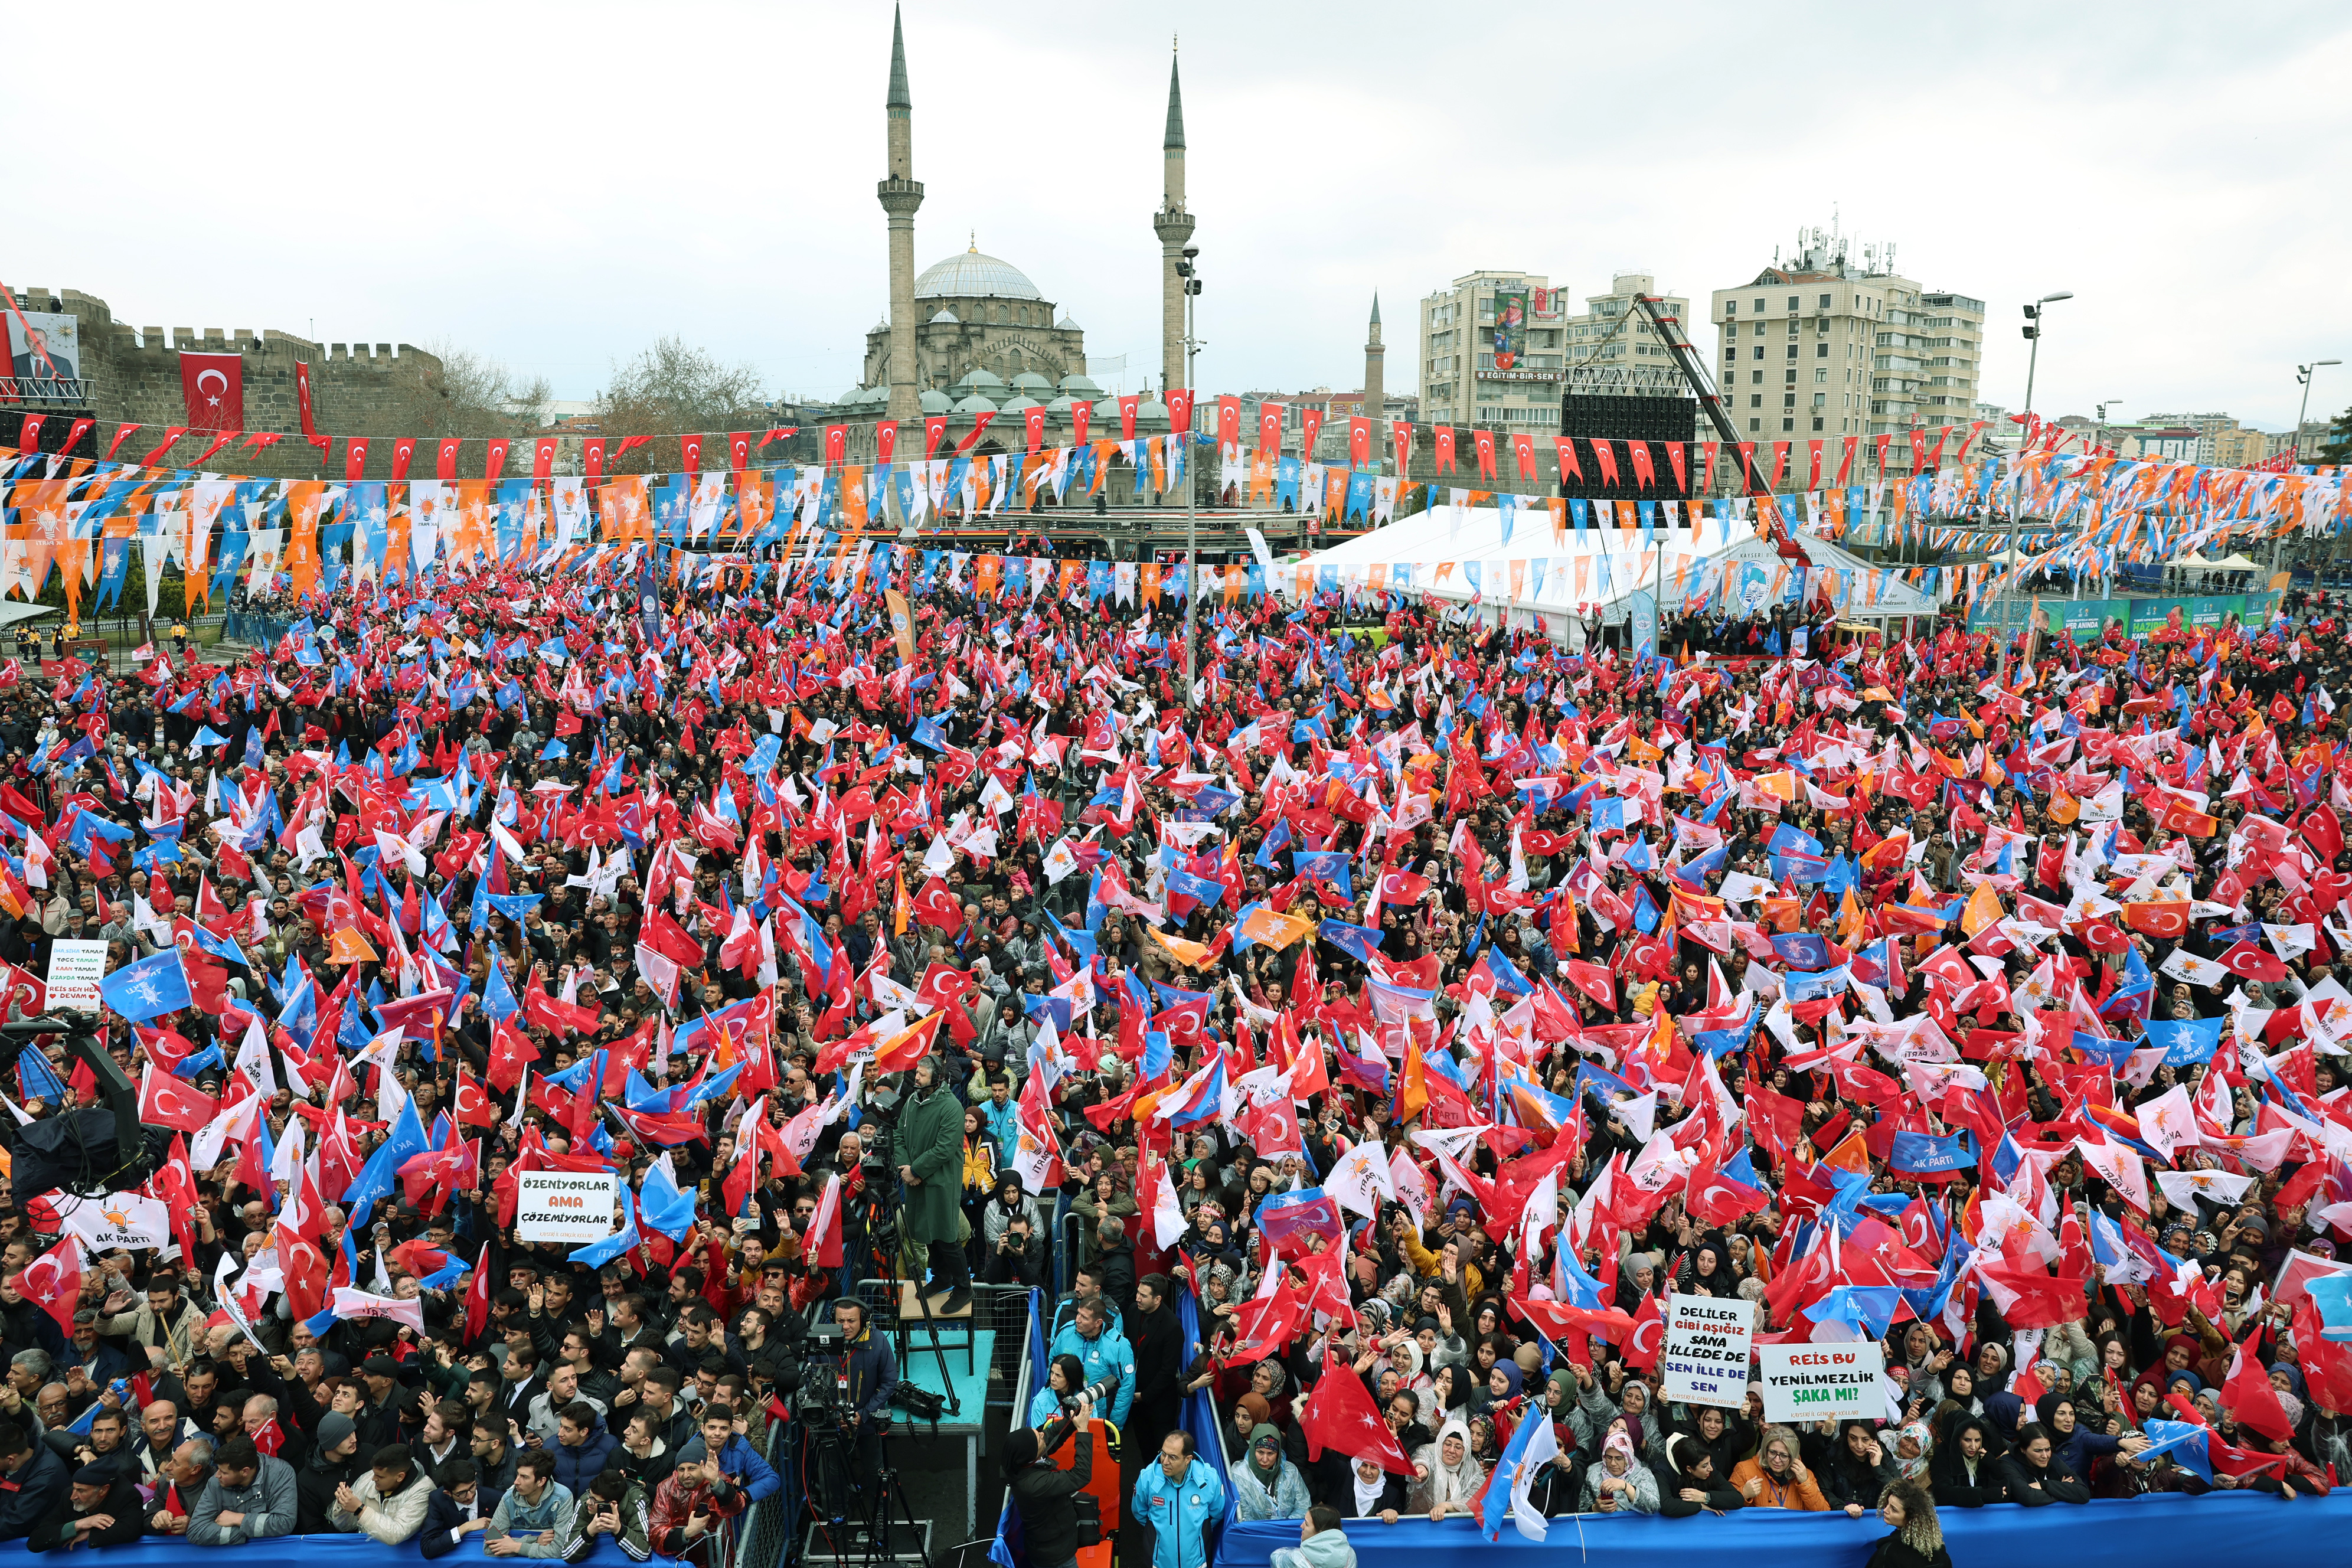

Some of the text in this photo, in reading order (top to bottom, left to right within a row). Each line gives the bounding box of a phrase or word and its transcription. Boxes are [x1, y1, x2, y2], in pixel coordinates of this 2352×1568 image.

[2132, 894, 2141, 902] AK
[1327, 933, 1337, 942] AK
[1496, 977, 1505, 986] AK
[523, 1178, 610, 1191] ÖZENİYORLAR
[1399, 1185, 1413, 1197] AK
[549, 1196, 583, 1208] AMA
[521, 1212, 607, 1224] ÇÖZEMİYORLAR
[96, 1233, 113, 1243] AK
[1680, 1307, 1737, 1321] DELİLER
[1675, 1319, 1745, 1335] GİBİ AŞIĞIZ
[1690, 1335, 1727, 1347] SANA
[1669, 1344, 1746, 1363] İLLEDE DE
[1789, 1351, 1856, 1366] REİS BU
[1666, 1362, 1746, 1380] SEN İLLE DE
[1769, 1370, 1874, 1386] YENİLMEZLİK
[1690, 1381, 1717, 1393] SEN
[1792, 1387, 1858, 1405] ŞAKA MI?
